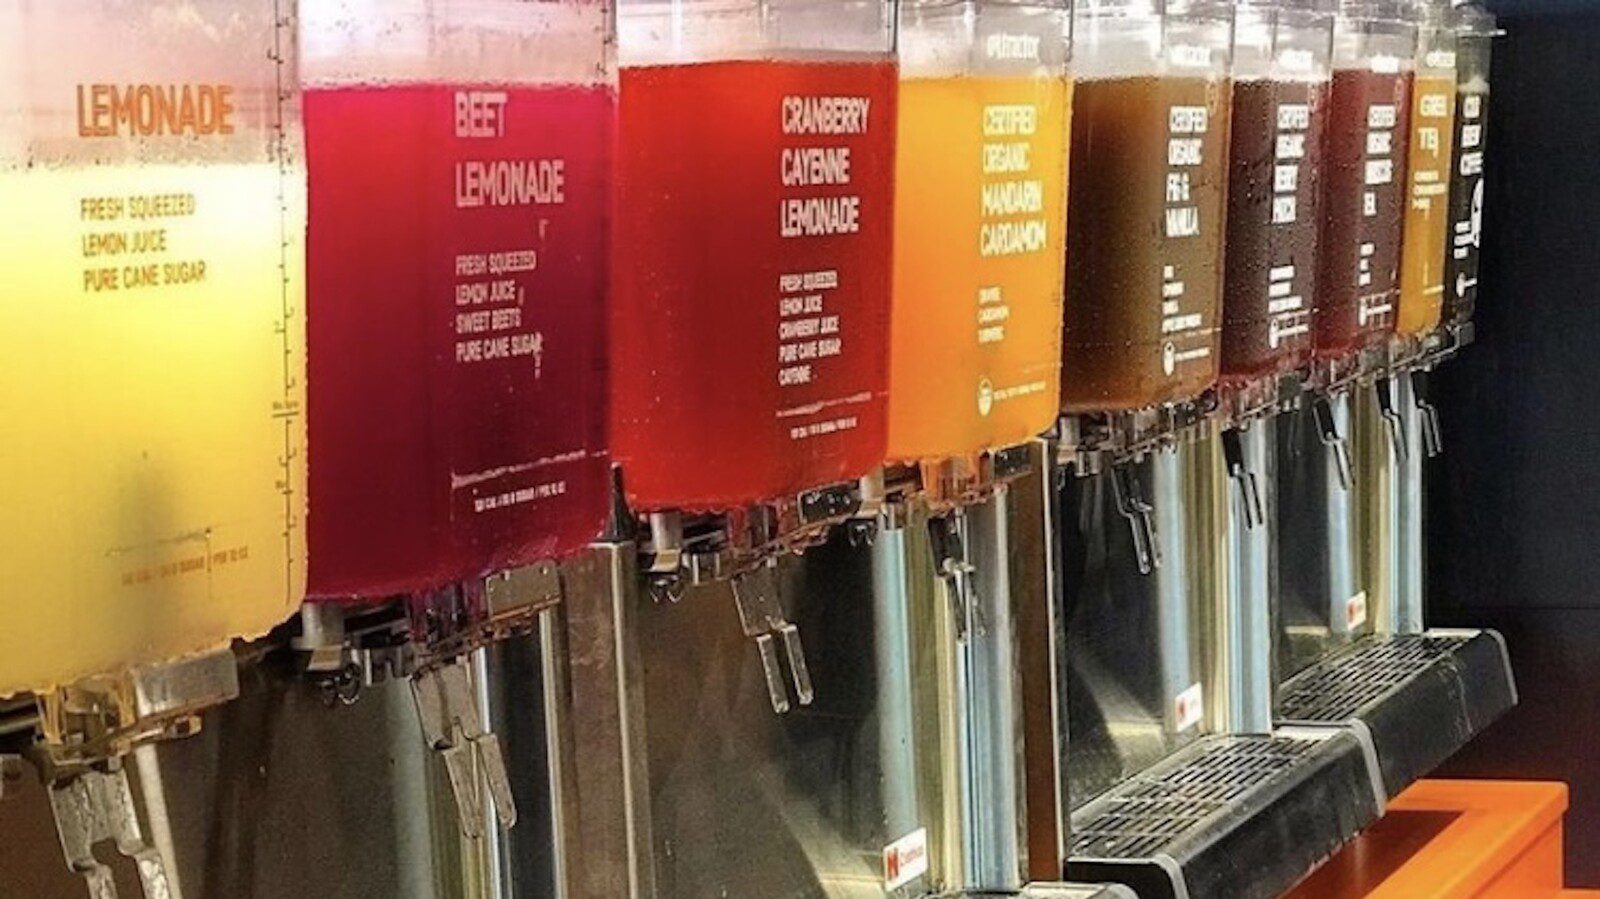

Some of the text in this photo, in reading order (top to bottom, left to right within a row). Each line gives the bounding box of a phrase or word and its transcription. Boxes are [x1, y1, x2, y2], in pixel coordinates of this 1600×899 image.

[77, 84, 235, 137] LEMONADE
[455, 91, 508, 137] BEET
[782, 96, 871, 134] CRANBERRY
[782, 148, 850, 186] CAYENNE
[982, 142, 1030, 175] ORGANIC
[456, 159, 564, 208] LEMONADE
[982, 180, 1042, 217] MANDARIN
[81, 193, 195, 220] FRESH SQUEEZED
[780, 197, 860, 237] LEMONADE
[82, 229, 167, 257] LEMON JUICE
[980, 219, 1046, 257] CARDAMOM
[83, 261, 206, 292] PURE CANE SUGAR
[456, 250, 537, 276] FRESH SQUEEZED
[456, 280, 515, 306] LEMON JUICE
[456, 308, 522, 334] SWEET BEETS
[456, 340, 482, 362] PURE
[483, 336, 510, 360] CANE
